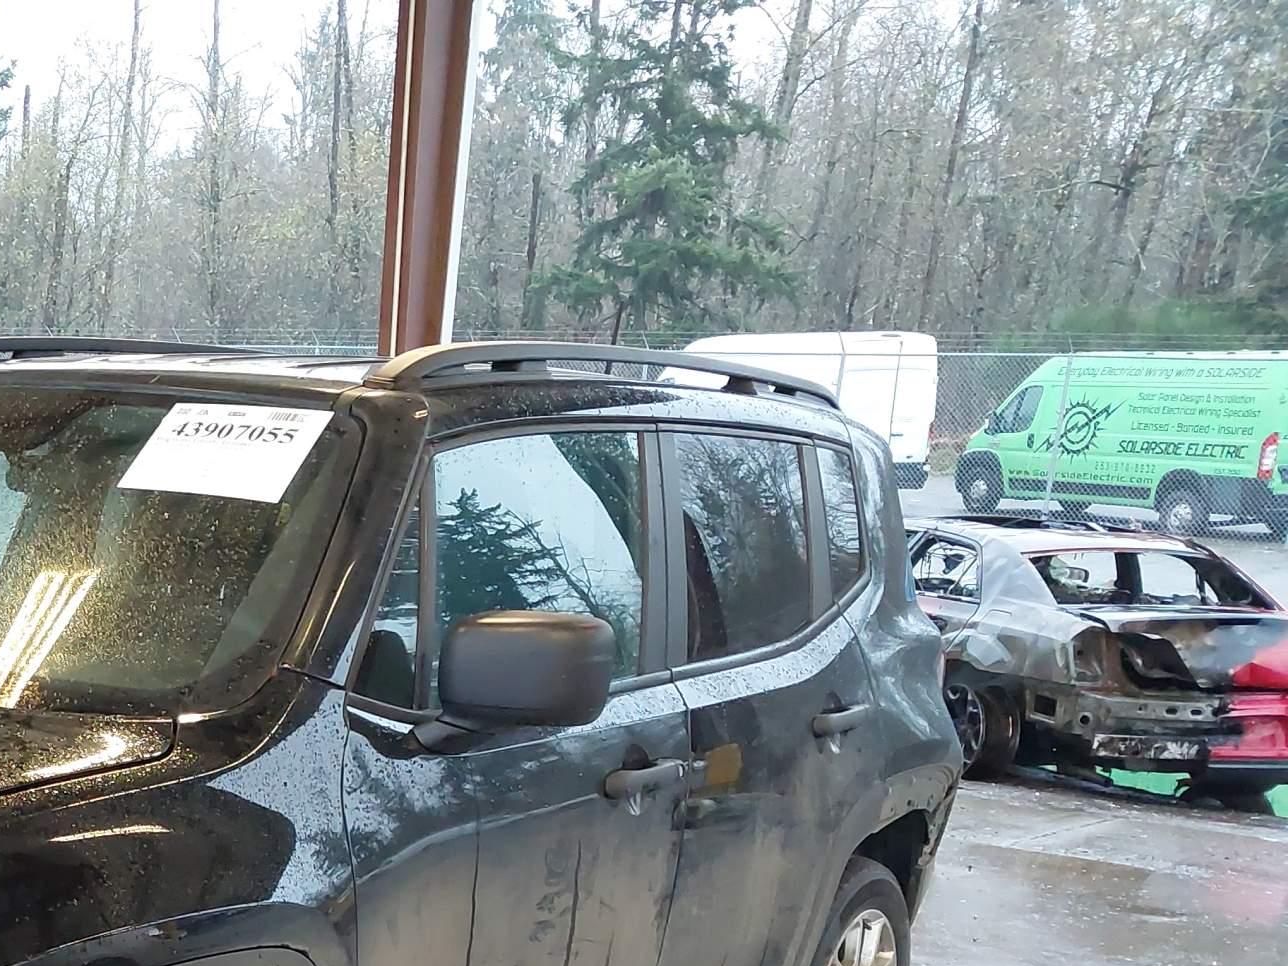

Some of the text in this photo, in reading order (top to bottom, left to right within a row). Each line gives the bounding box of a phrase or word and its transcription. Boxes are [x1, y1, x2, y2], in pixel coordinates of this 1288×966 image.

[1058, 367, 1099, 377] Eeryday
[1100, 367, 1144, 376] Electrical
[1145, 367, 1173, 379] Wiring
[1205, 368, 1266, 378] SOLARSIDE
[1158, 393, 1179, 401] Panel
[1180, 394, 1204, 405] Design
[1128, 404, 1262, 419] Technical Electrical Wiring Specialist
[172, 421, 299, 444] 43907055
[1131, 421, 1169, 432] Licensed
[1176, 423, 1210, 434] Bonded
[1217, 425, 1254, 436] Insured
[1117, 440, 1249, 459] SOLARSIDE ELECTRIC
